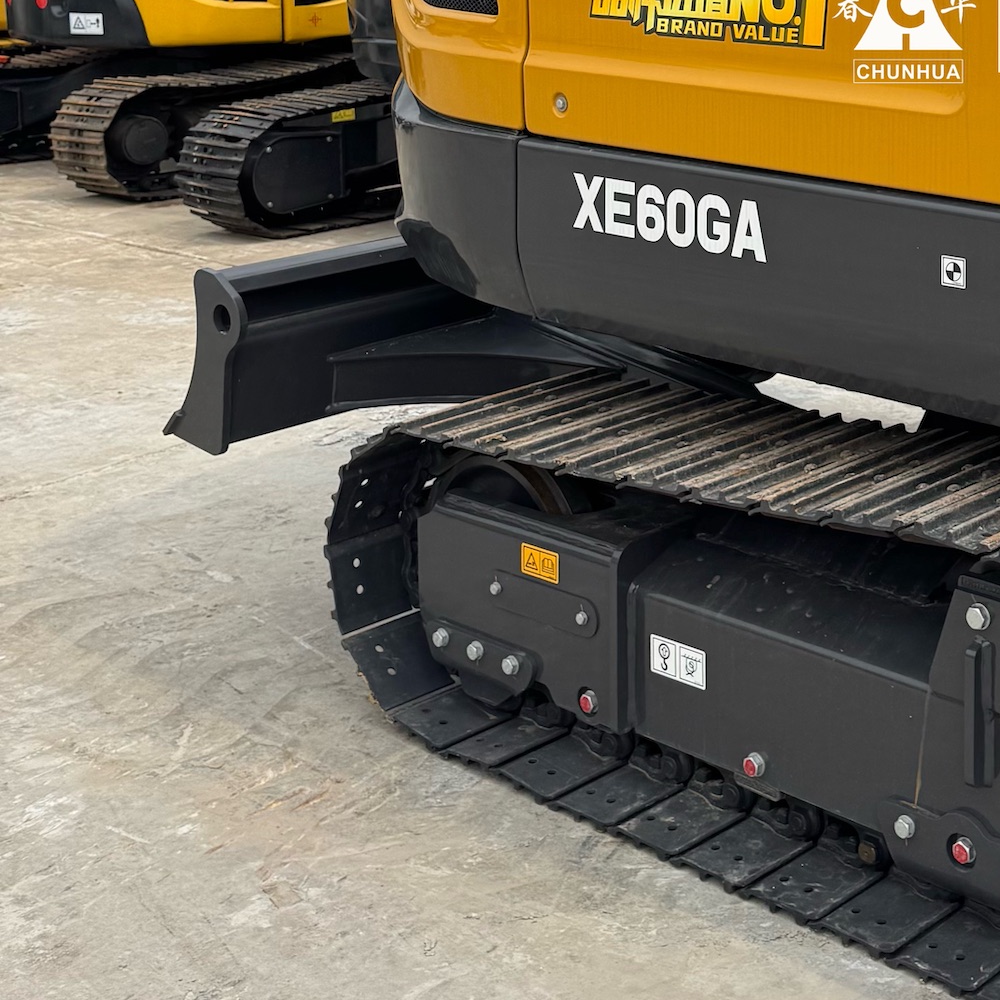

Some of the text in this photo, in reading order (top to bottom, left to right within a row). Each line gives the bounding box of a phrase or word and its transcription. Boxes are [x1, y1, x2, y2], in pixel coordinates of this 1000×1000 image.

[656, 17, 800, 44] BRAND VALUE
[572, 172, 767, 264] XE60GA
